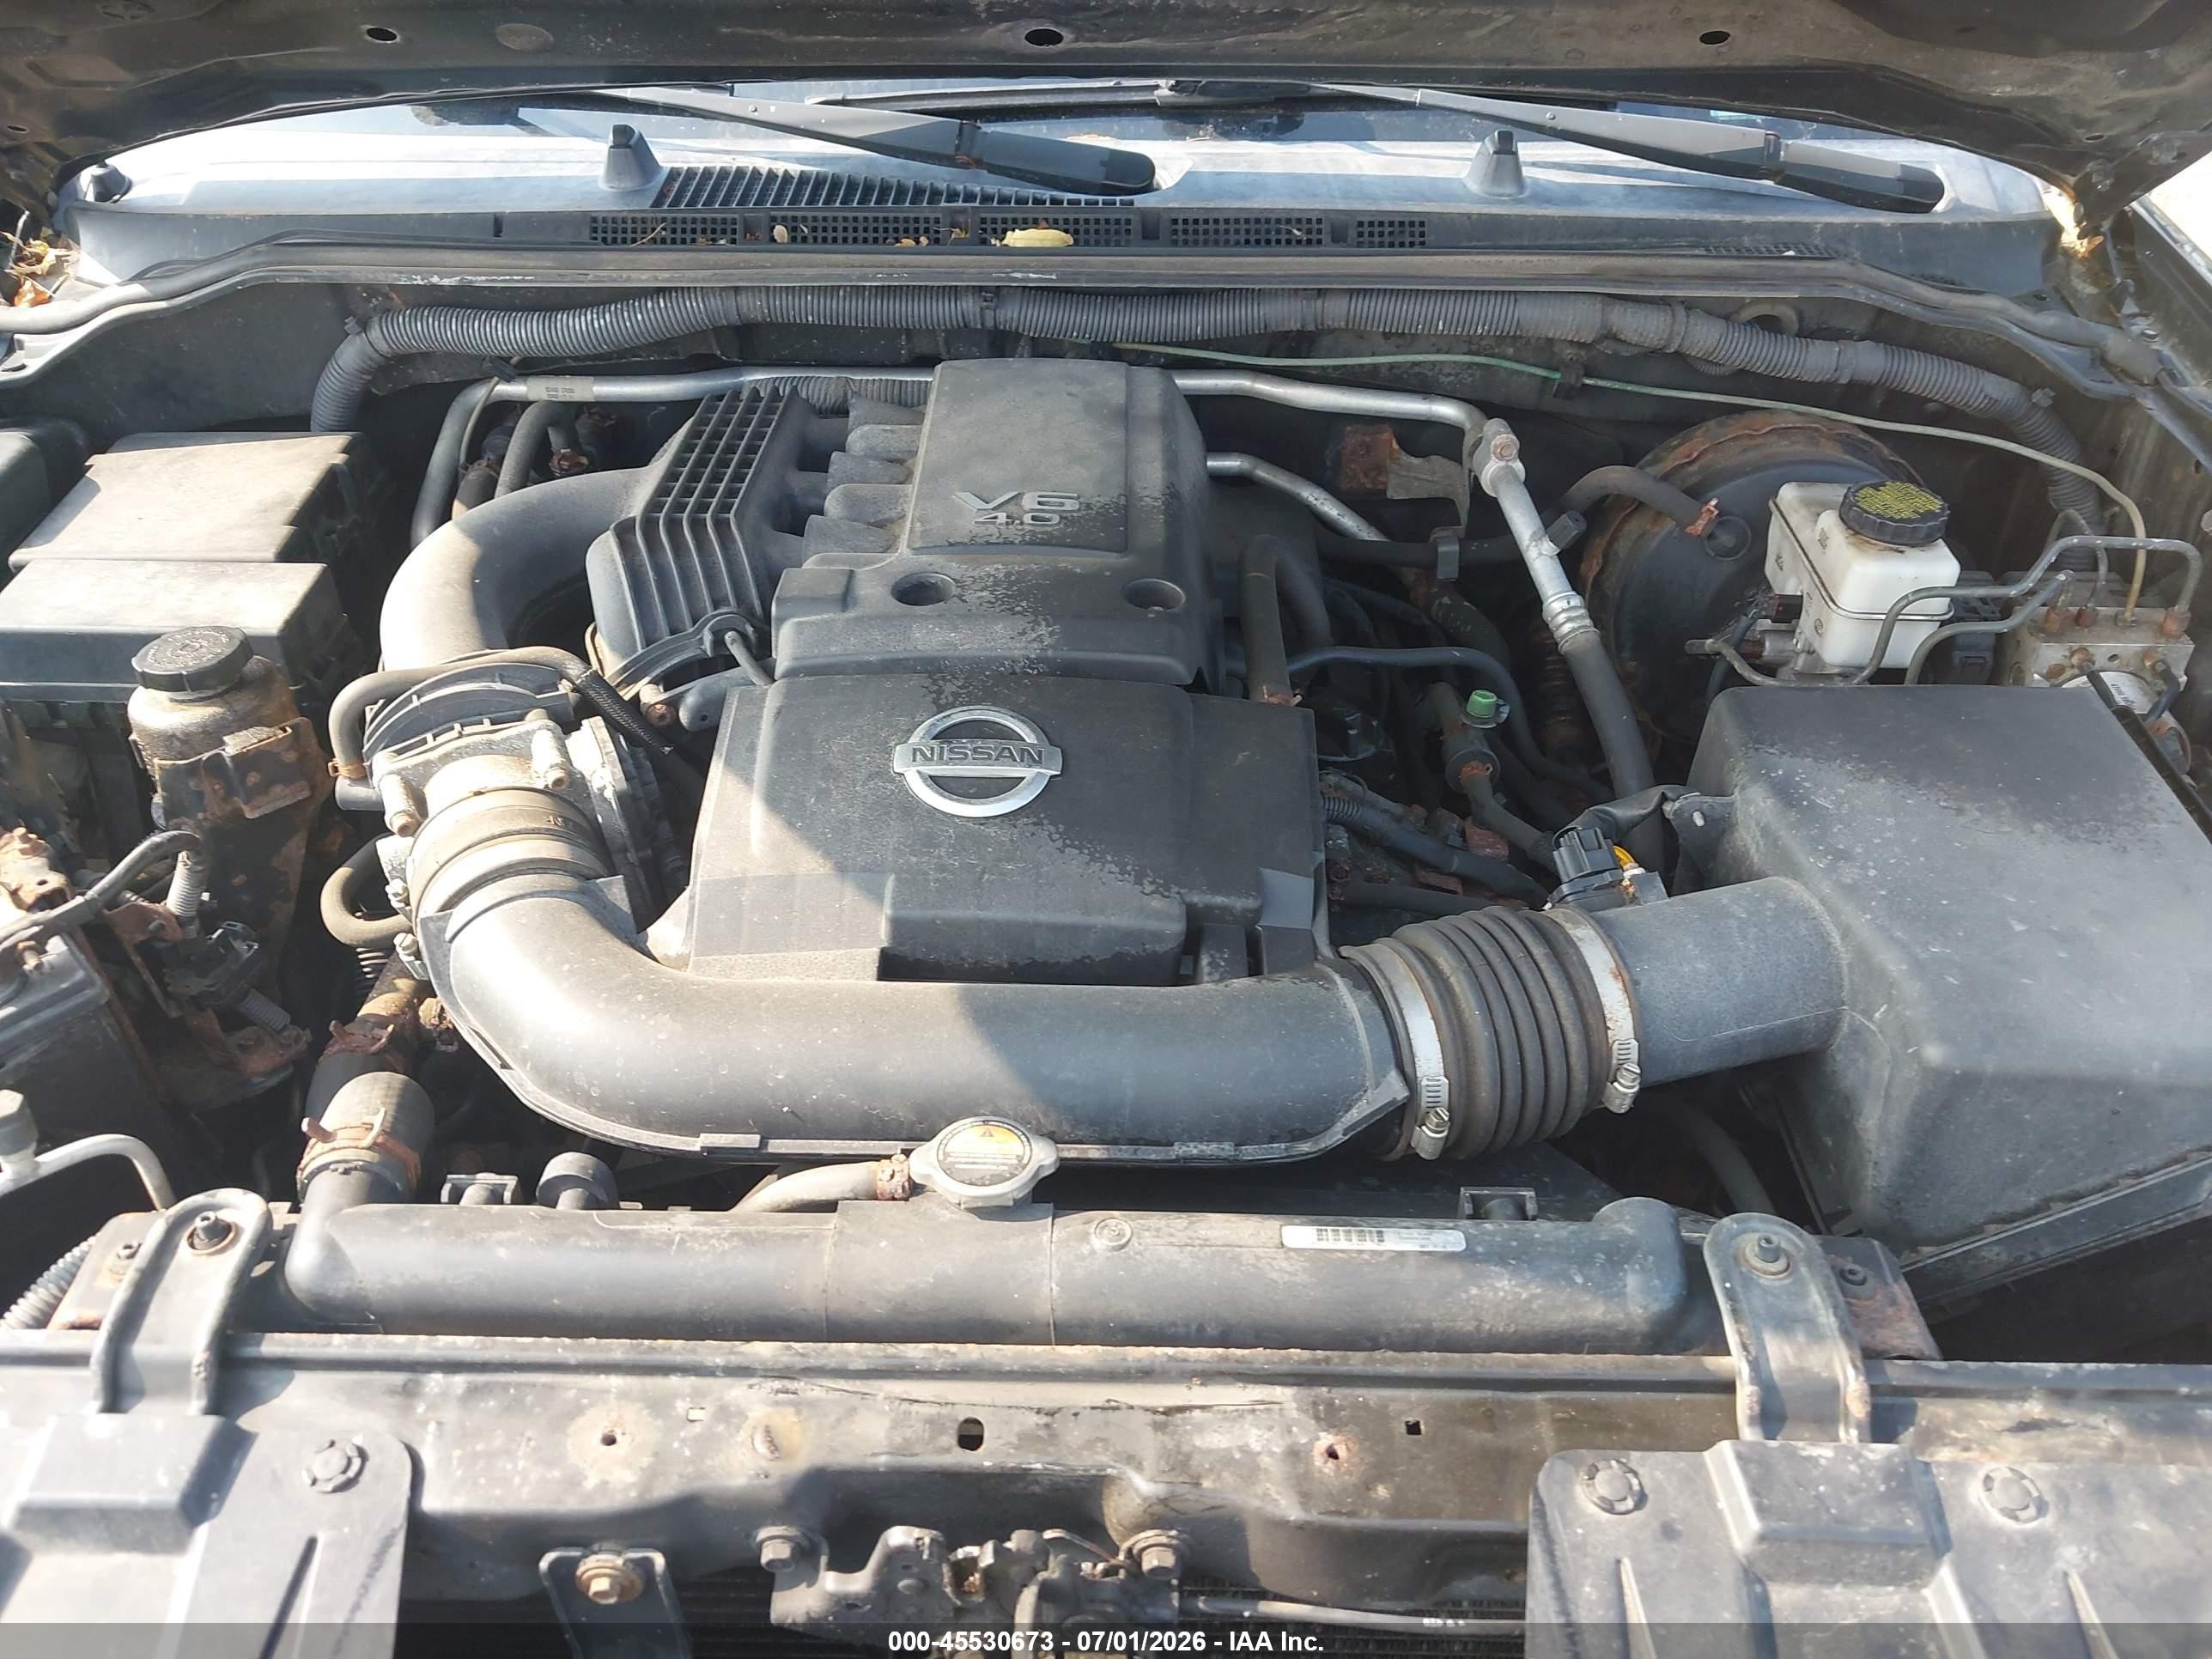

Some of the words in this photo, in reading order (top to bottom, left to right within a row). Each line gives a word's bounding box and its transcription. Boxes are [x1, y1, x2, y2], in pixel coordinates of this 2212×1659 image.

[951, 491, 1080, 513] V6
[972, 512, 1060, 526] 4.0
[912, 744, 1044, 765] NISSAN
